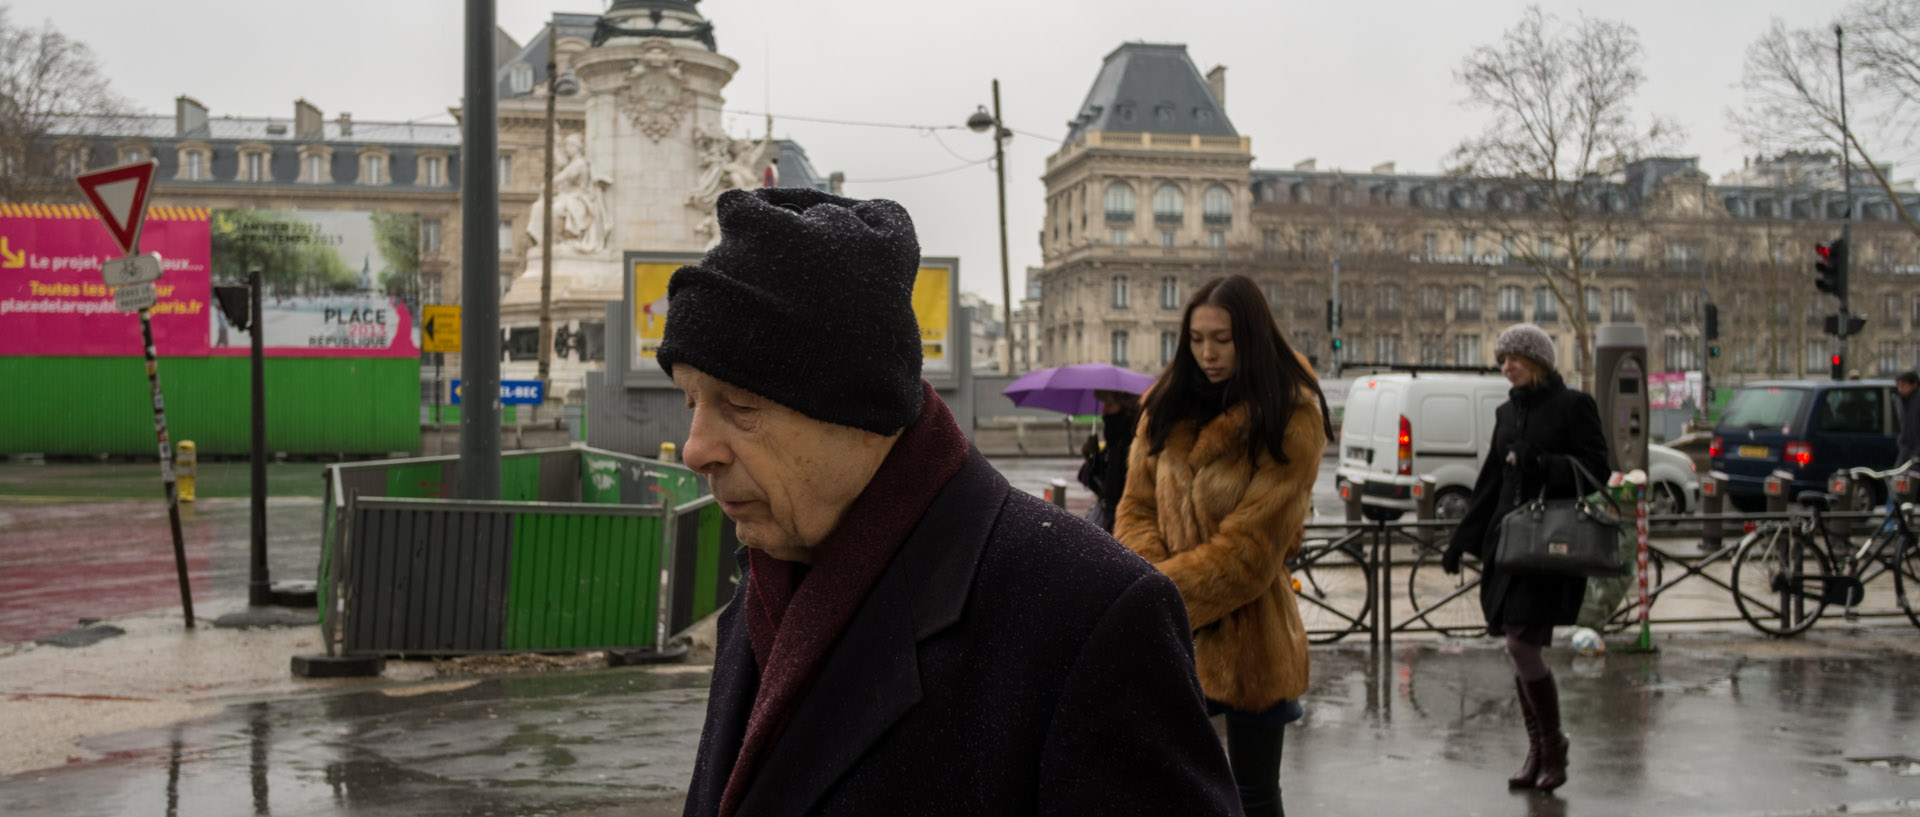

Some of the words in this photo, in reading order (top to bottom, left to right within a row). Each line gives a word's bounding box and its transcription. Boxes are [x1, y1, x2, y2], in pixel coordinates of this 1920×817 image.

[30, 254, 49, 269] Le
[29, 280, 80, 297] Toutes
[82, 281, 106, 297] les
[324, 308, 386, 325] PLACE
[349, 323, 387, 337] 2013
